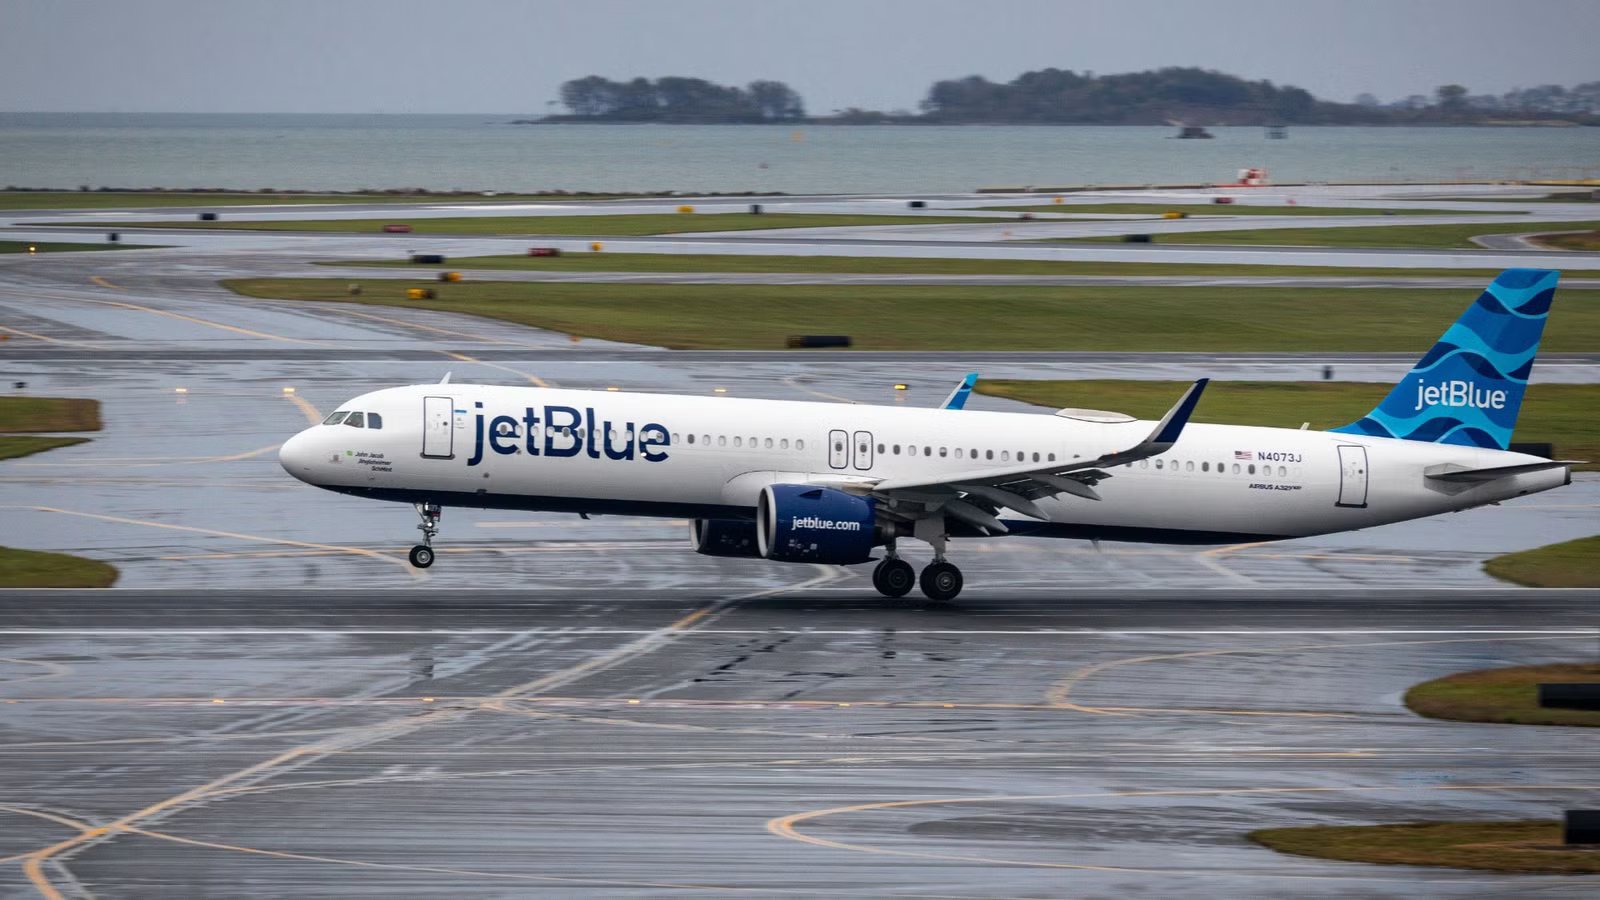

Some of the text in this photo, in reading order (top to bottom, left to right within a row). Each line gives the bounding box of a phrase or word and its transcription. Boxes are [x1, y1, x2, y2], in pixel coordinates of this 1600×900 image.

[1415, 379, 1506, 411] jetBlue
[467, 401, 671, 466] jetBlue
[1258, 452, 1302, 463] N4073J
[791, 516, 860, 531] jetblue.com
